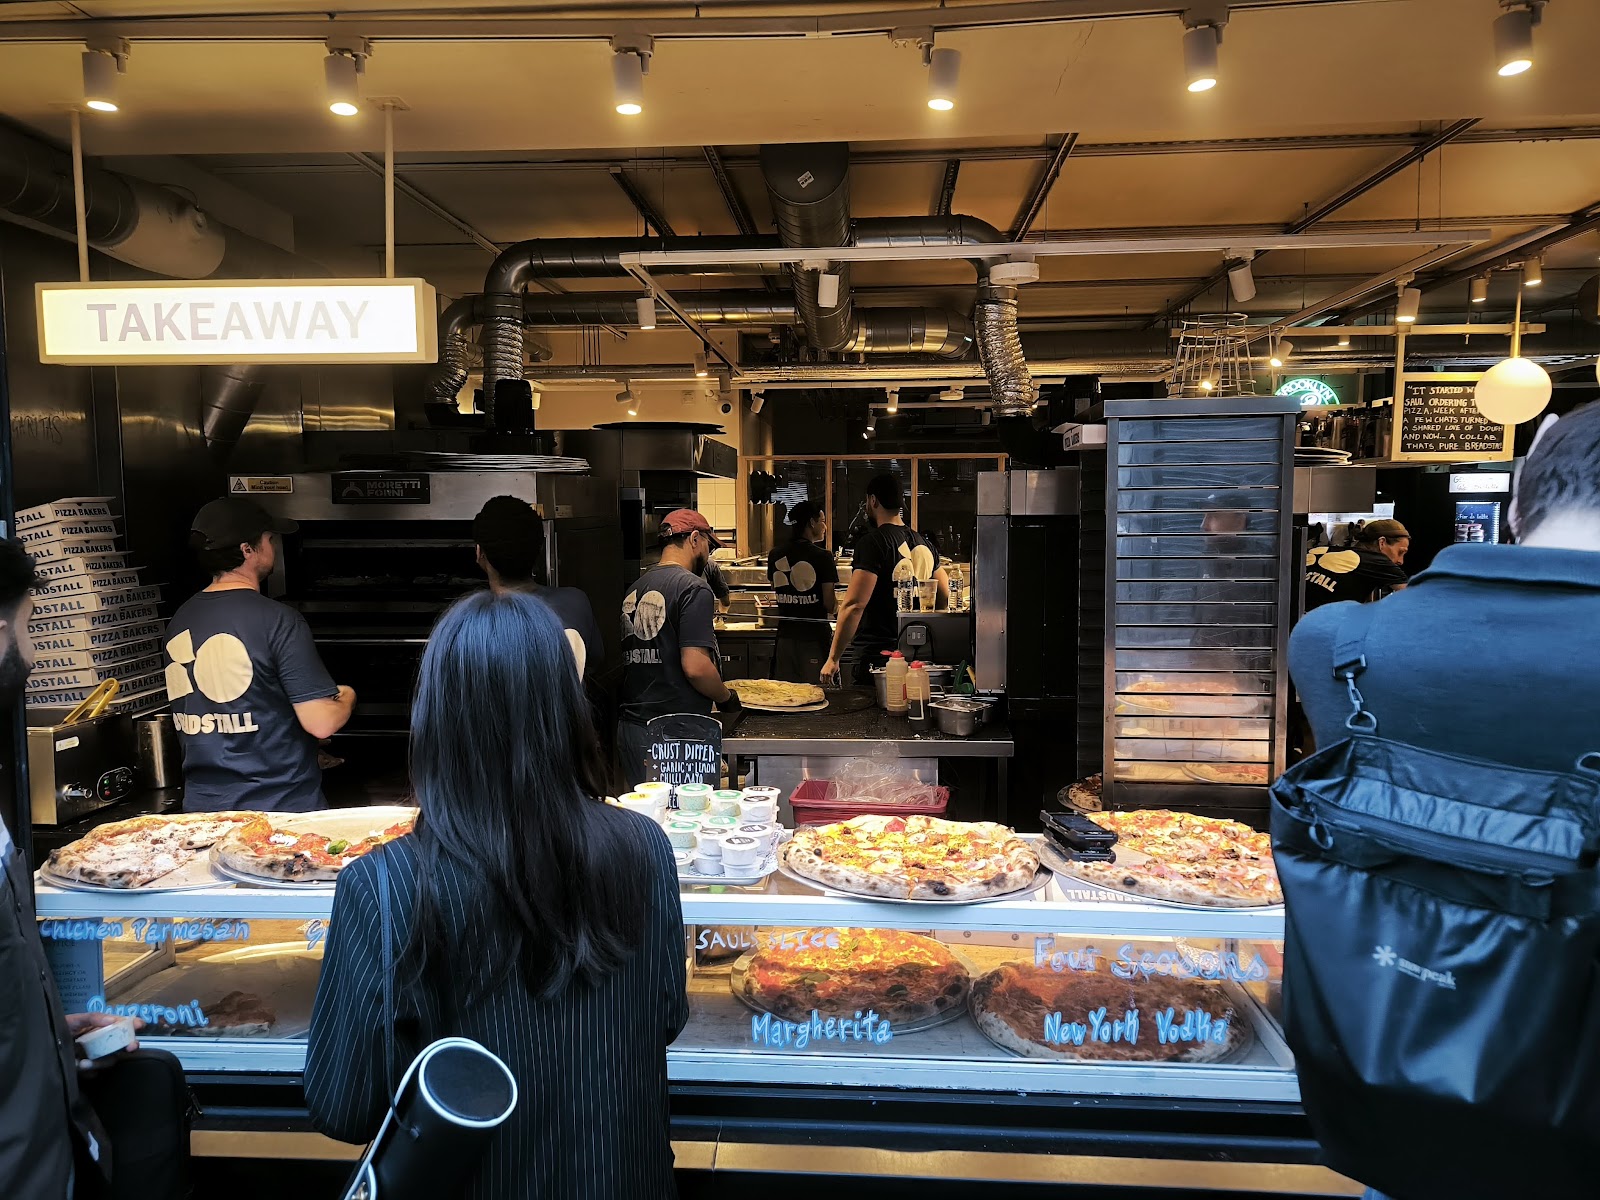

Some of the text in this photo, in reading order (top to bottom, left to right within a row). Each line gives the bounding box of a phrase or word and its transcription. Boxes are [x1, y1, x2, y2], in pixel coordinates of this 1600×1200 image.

[86, 300, 369, 342] TAKEAWAY
[1429, 386, 1463, 395] STARTED
[1404, 398, 1424, 406] SAUL
[1428, 398, 1468, 407] ORDERING
[1460, 416, 1489, 425] TURNED
[1403, 433, 1420, 441] AND
[1439, 442, 1459, 450] PURE
[366, 481, 421, 489] MORETTI
[366, 489, 404, 497] FORNI
[55, 506, 108, 517] PIZZA BAKERS
[61, 524, 113, 535] PIZZA BAKERS
[63, 543, 113, 555] PIZZA BAKERS
[85, 560, 124, 570] PIZZA BAKERS
[92, 575, 137, 588] PIZZA BAKERS
[101, 590, 156, 607] PIZZA BAKERS
[91, 607, 153, 626] PIZZA BAKERS
[90, 624, 160, 645] PIZZA BAKERS
[92, 642, 153, 663] PIZZA BAKERS
[97, 659, 157, 681] PIZZA BAKERS
[651, 743, 715, 762] CRUST DIPPER
[660, 761, 685, 774] GARLIC
[695, 761, 716, 774] LEMON
[660, 773, 704, 784] CHILLI MAYO
[131, 917, 250, 945] Parmesan
[766, 928, 840, 952] SLICE
[1033, 936, 1270, 985] Four Seasons
[751, 1009, 893, 1049] Margherita
[1043, 1011, 1087, 1046] New
[1155, 1007, 1228, 1046] Vodka
